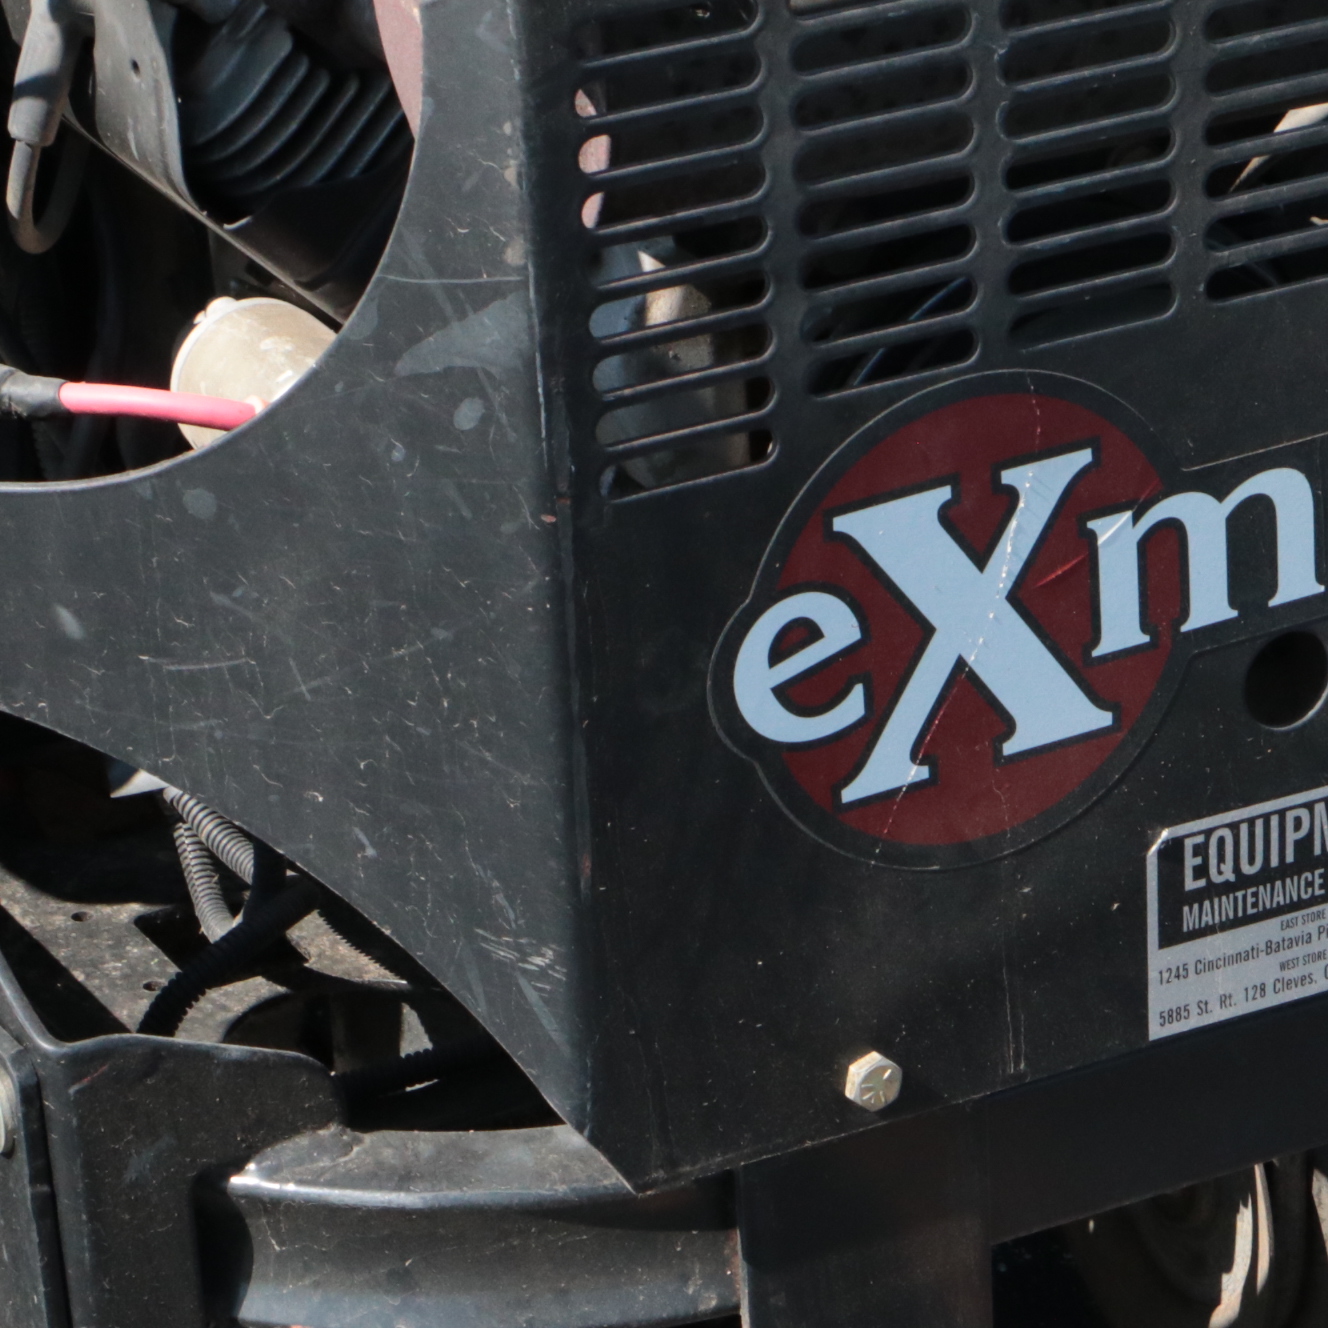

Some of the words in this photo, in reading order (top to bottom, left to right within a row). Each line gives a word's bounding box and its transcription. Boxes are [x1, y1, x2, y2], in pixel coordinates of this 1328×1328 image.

[1182, 867, 1326, 933] MAINTENANCE
[1280, 914, 1299, 931] EAST
[1301, 908, 1327, 926] STORE
[1158, 962, 1189, 986] 1245
[1194, 930, 1312, 975] Cincinnati-Batavia
[1279, 956, 1300, 972] WEST
[1302, 949, 1327, 967] STORE
[1158, 1003, 1190, 1027] 5885
[1197, 997, 1213, 1016] St.
[1219, 990, 1237, 1010] Rt.
[1243, 981, 1267, 1003] 128
